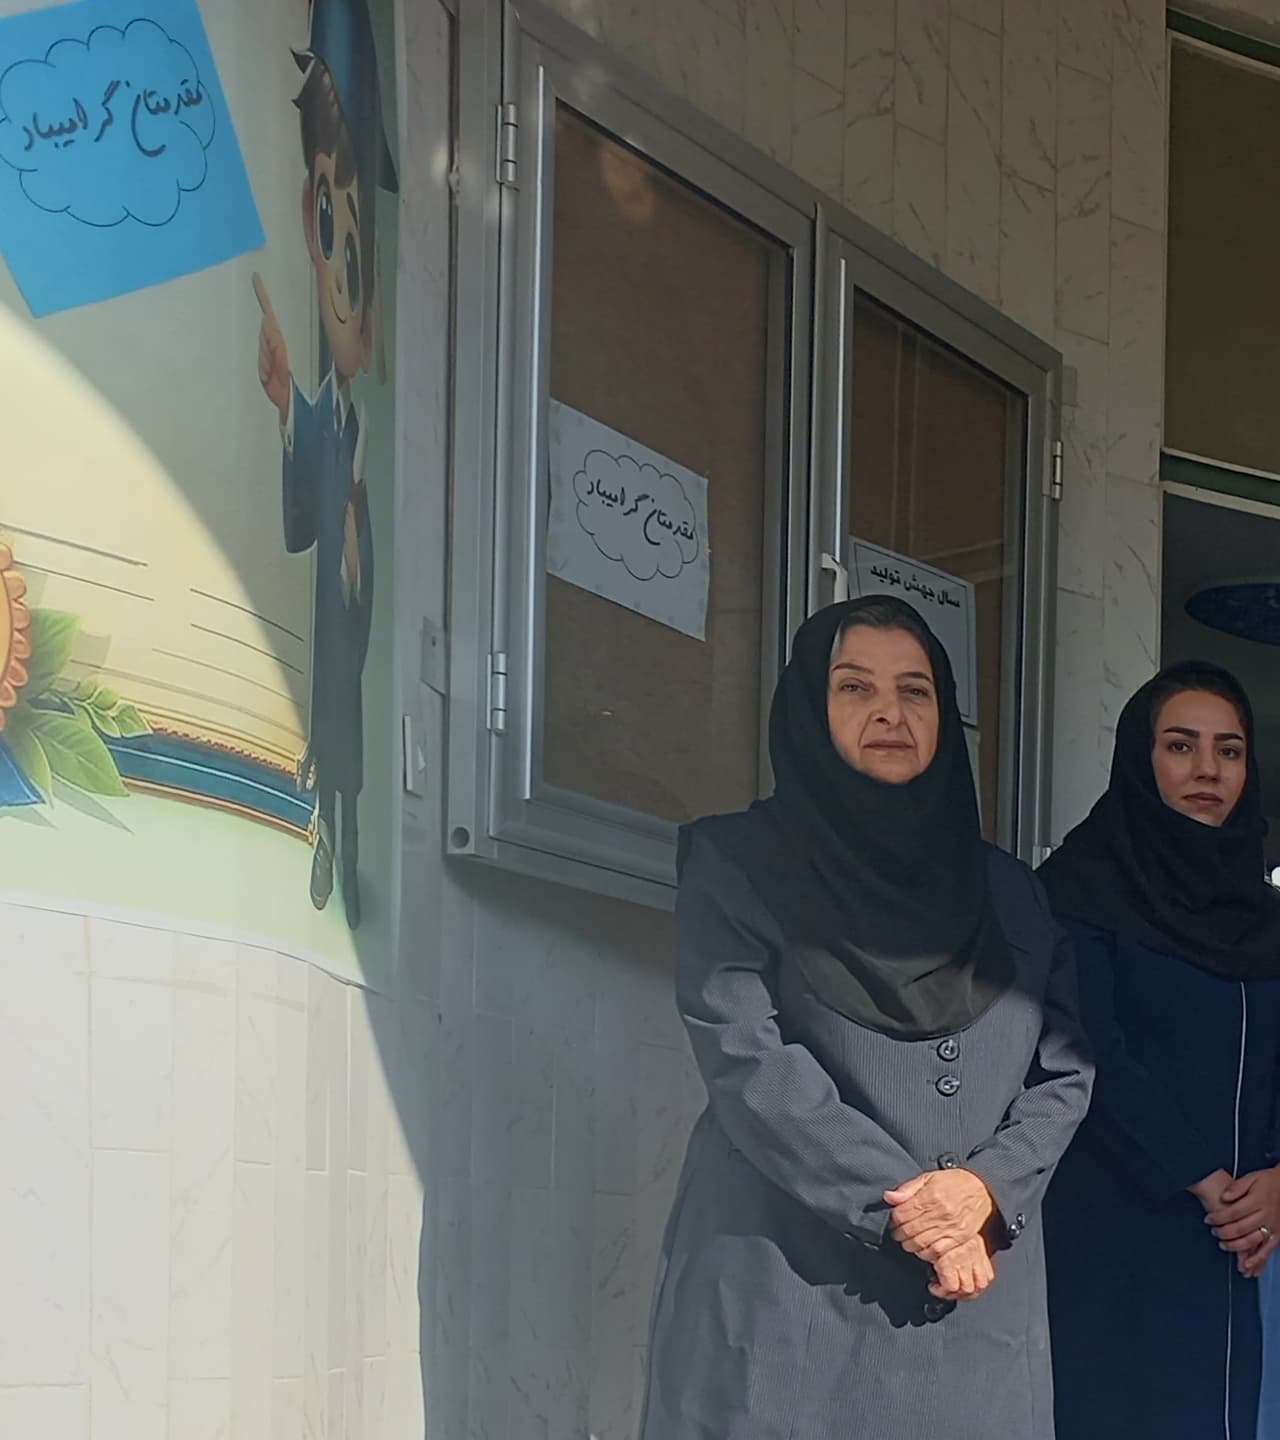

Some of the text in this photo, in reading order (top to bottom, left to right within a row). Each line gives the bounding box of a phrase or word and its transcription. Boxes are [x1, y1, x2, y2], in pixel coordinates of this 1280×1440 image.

[870, 565, 960, 608] سال جهش تولید
